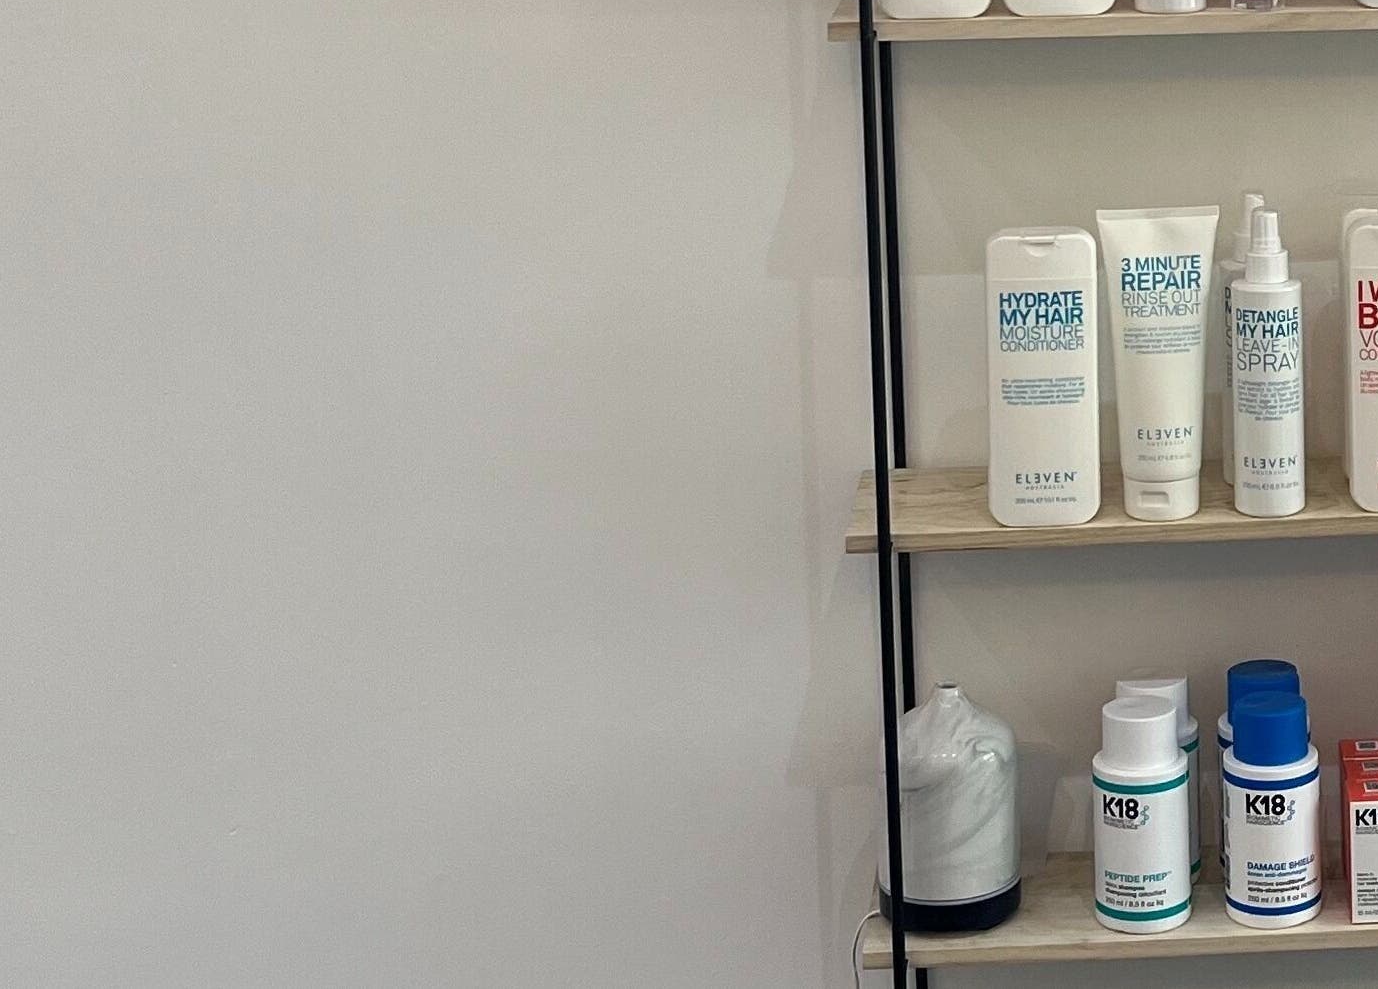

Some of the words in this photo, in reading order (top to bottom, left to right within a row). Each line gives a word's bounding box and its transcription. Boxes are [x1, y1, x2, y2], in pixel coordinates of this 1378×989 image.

[1121, 258, 1131, 272] 3
[1135, 255, 1201, 271] MINUTE
[1121, 270, 1201, 291] REPAIR
[1121, 290, 1167, 305] RINSE
[1171, 289, 1201, 304] OUT
[1357, 280, 1363, 302] I
[1000, 291, 1083, 308] HYDRATE
[1000, 309, 1033, 326] MY
[1035, 307, 1083, 325] HAIR
[1123, 303, 1200, 318] TREATMENT
[1235, 307, 1299, 323] DETANGLE
[1000, 324, 1084, 341] MOISTURE
[1236, 323, 1258, 338] MY
[1262, 321, 1299, 339] HAIR
[1000, 339, 1084, 352] CONDITIONER
[1236, 337, 1300, 353] LEAVE-IN
[1237, 351, 1299, 372] SPRAY
[1137, 428, 1193, 440] ELEVEN
[1243, 456, 1297, 469] ELEVEN
[1015, 471, 1075, 484] ELEVEN
[1103, 794, 1139, 819] K18
[1246, 793, 1286, 816] K18
[1247, 861, 1287, 871] DAMAGE
[1104, 870, 1140, 883] PEPTIDE
[1142, 872, 1168, 883] PREP
